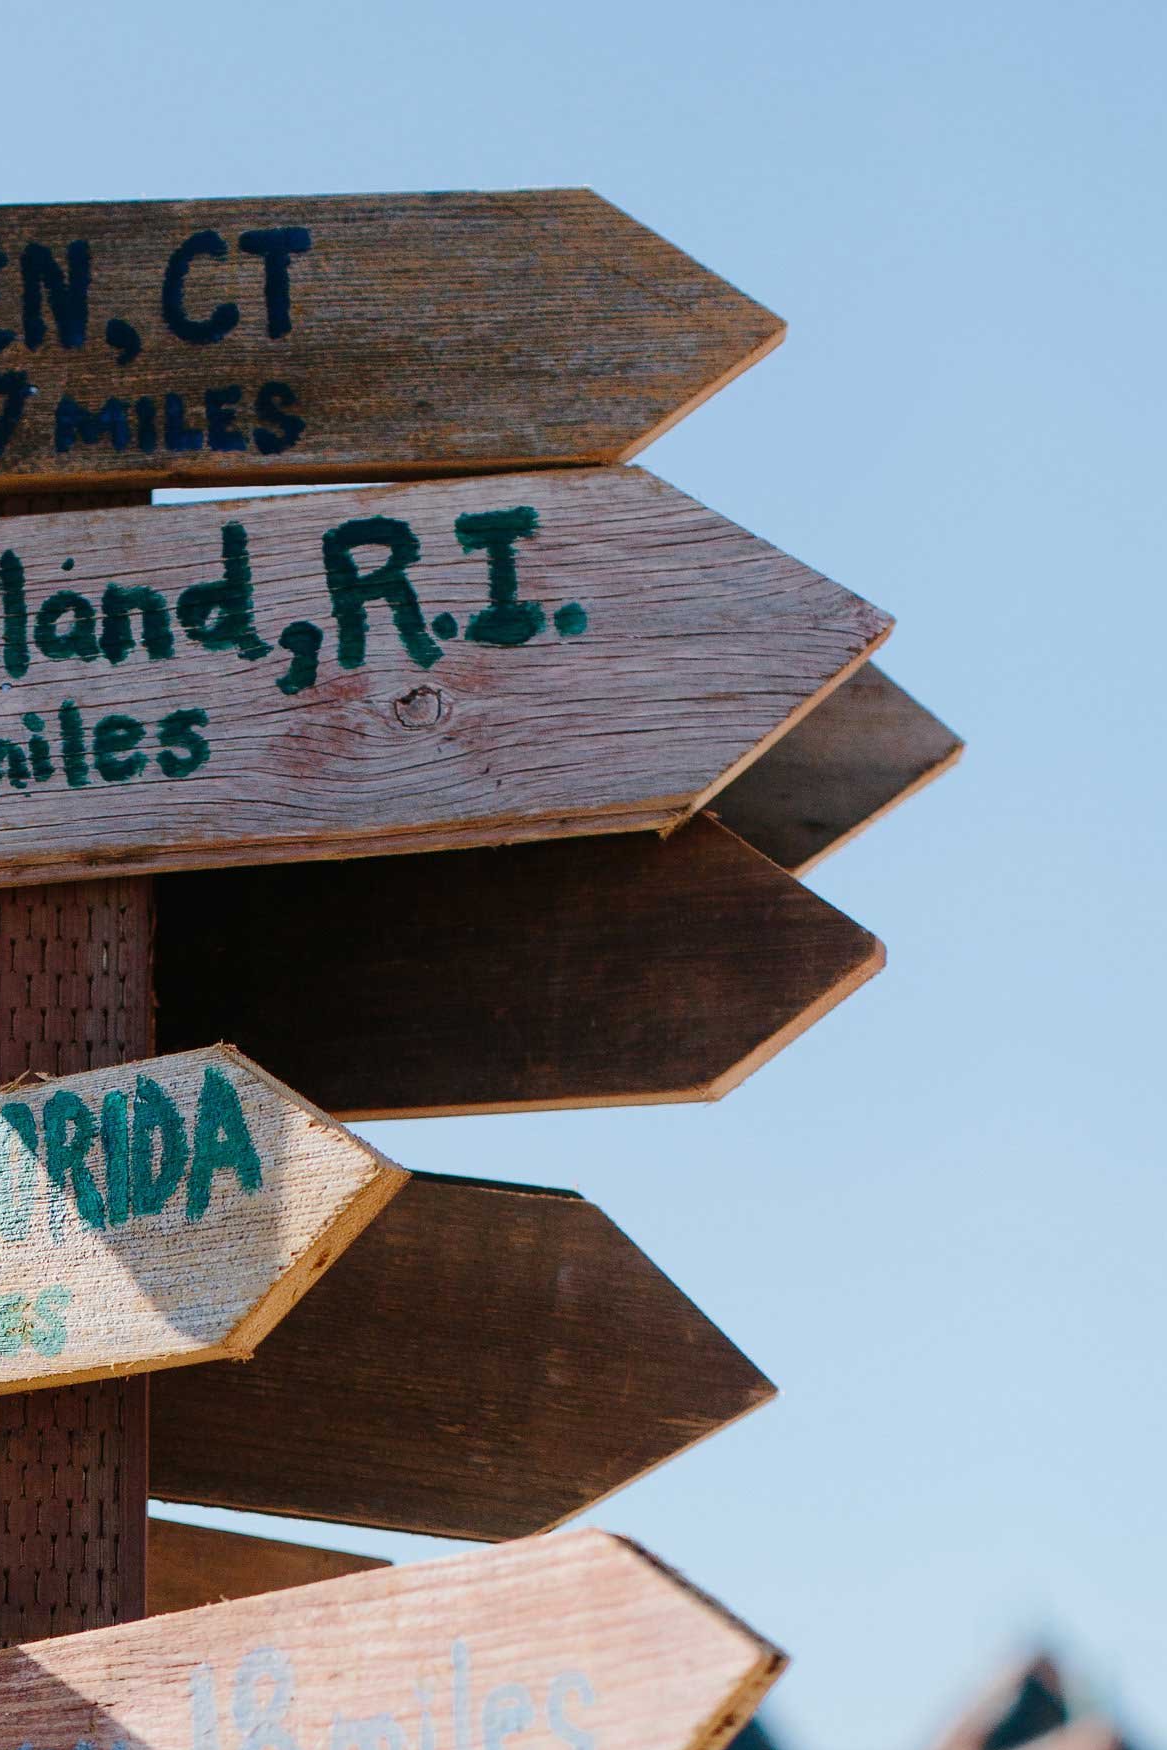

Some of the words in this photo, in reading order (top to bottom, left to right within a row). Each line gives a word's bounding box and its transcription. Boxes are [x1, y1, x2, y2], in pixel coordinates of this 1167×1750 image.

[162, 226, 311, 345] CT
[55, 380, 306, 456] MILES
[322, 506, 590, 670] R.I.
